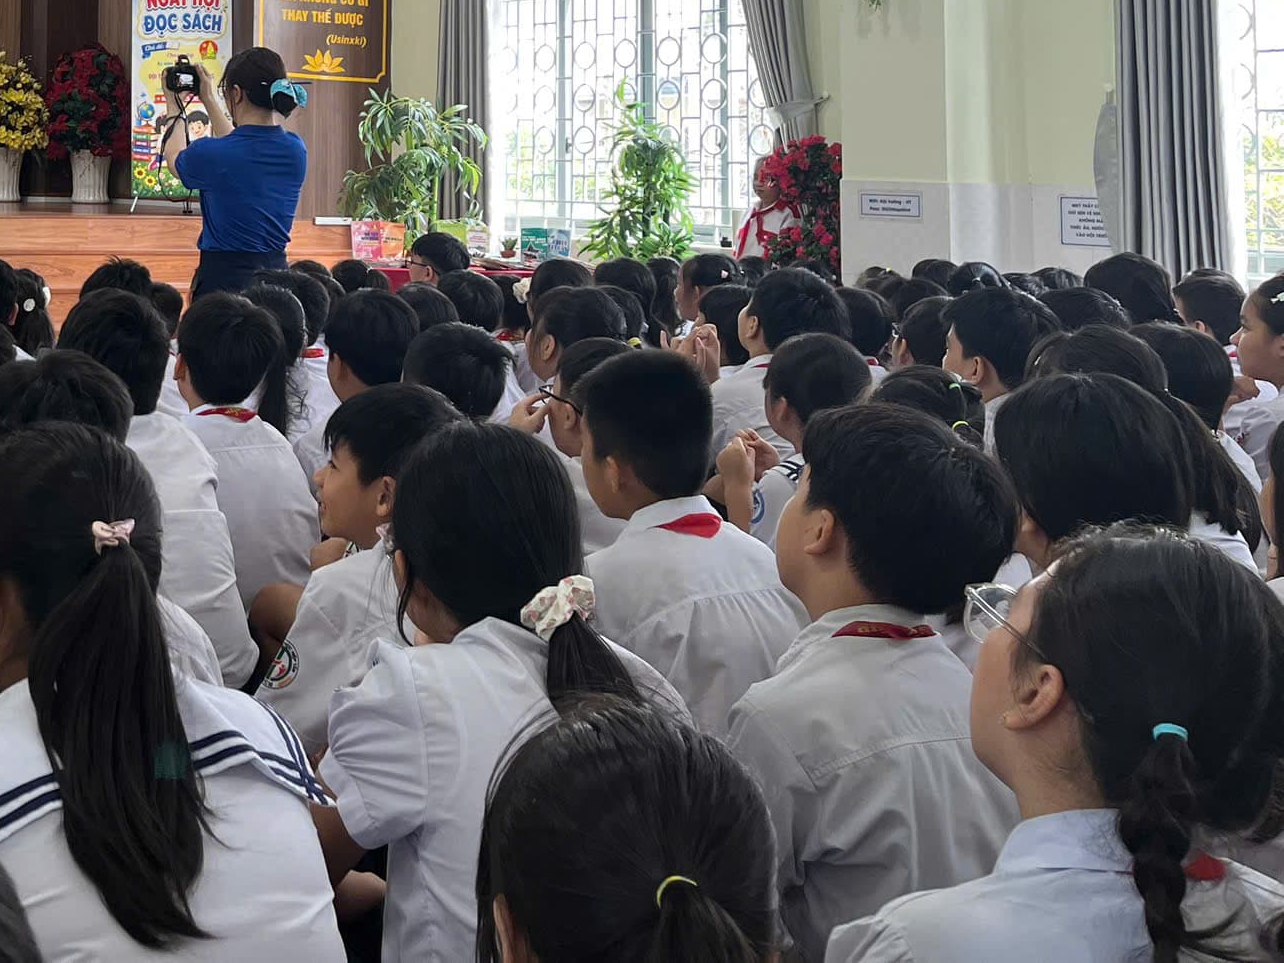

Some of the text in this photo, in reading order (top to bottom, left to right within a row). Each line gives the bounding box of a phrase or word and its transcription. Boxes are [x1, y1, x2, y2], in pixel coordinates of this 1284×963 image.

[144, 9, 222, 35] ĐỌC SÁCH
[282, 9, 309, 21] THAY
[311, 8, 333, 24] THẾ
[326, 34, 367, 48] (Usinxki)
